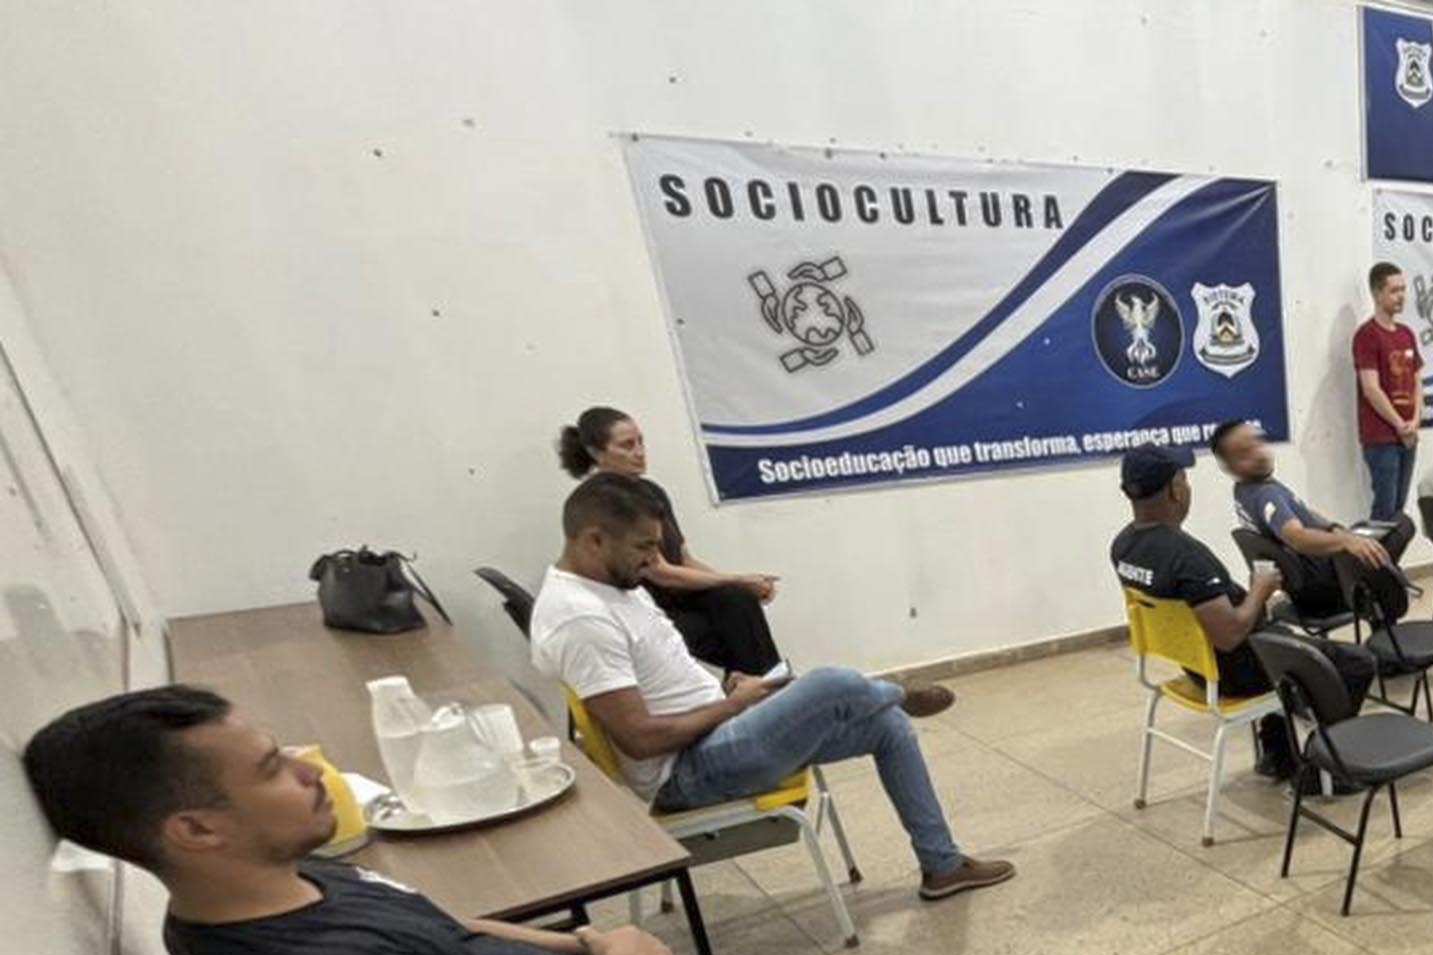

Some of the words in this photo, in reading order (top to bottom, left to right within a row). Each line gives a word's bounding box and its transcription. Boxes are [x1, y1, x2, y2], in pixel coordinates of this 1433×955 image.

[659, 173, 1064, 229] SOCIOCULTURA
[757, 444, 931, 484] Socioeducação
[933, 444, 972, 467] que
[1082, 427, 1170, 450] esperança
[1172, 424, 1201, 444] que
